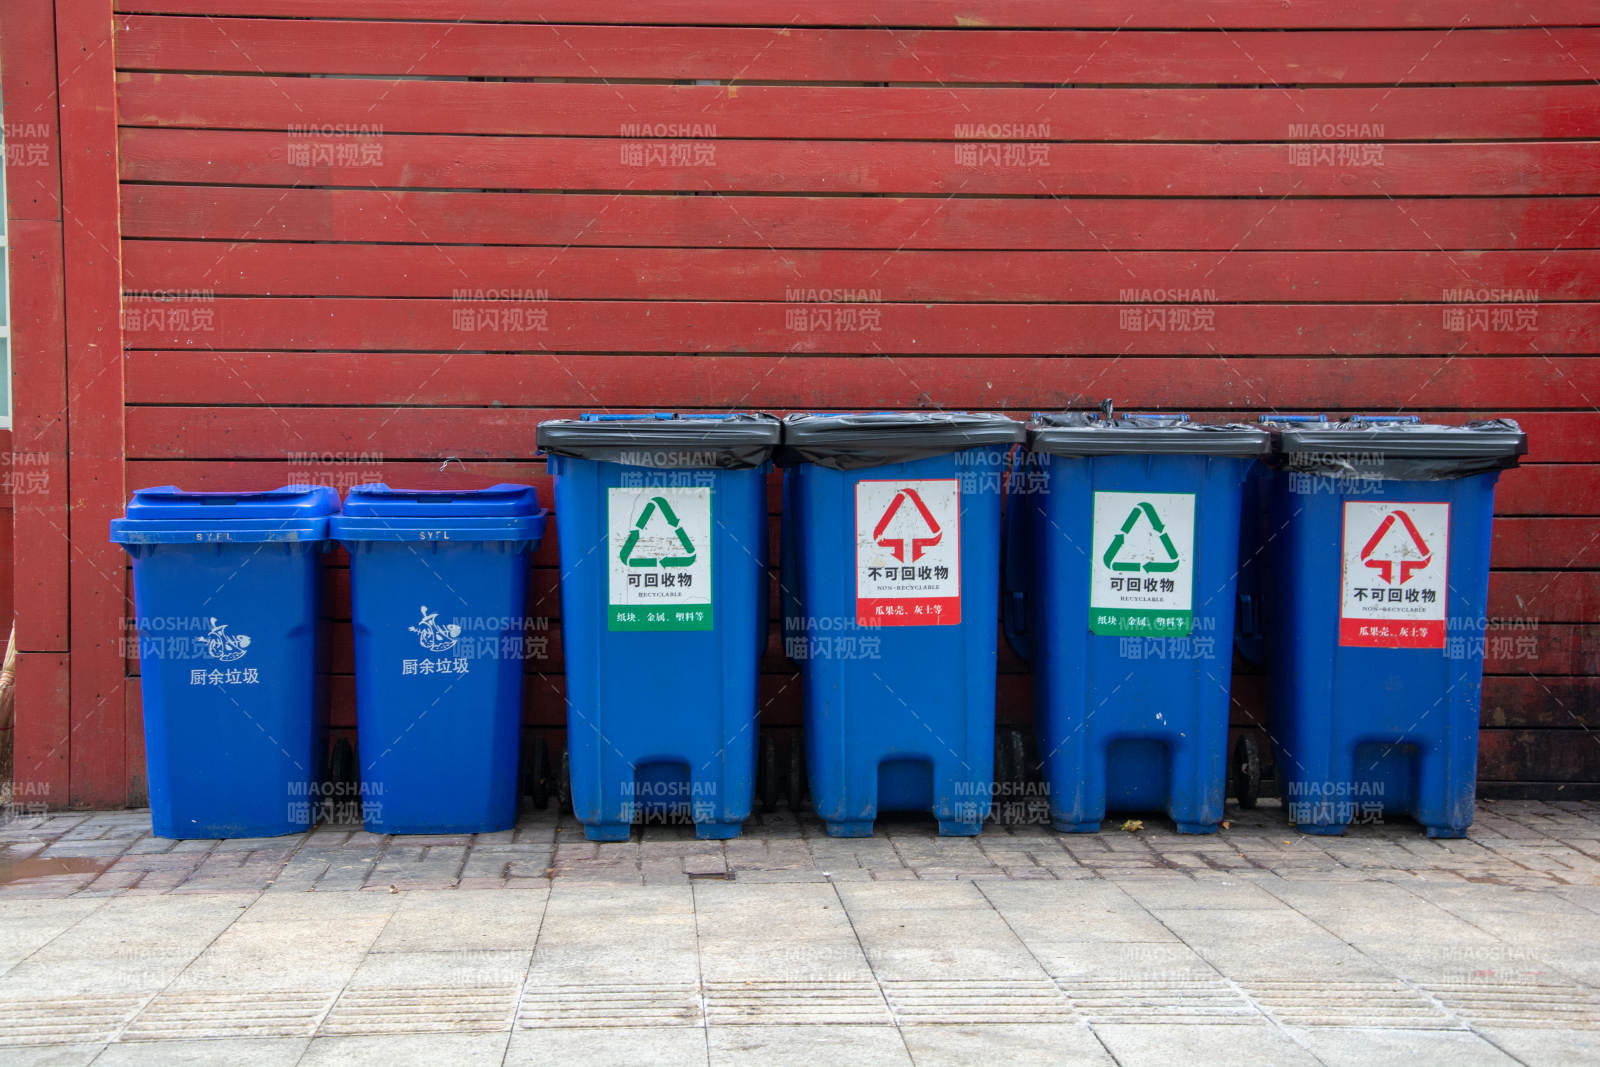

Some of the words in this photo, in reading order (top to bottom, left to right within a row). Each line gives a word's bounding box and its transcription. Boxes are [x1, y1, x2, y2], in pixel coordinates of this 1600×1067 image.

[628, 573, 693, 588] 可回收物
[868, 566, 949, 581] 不可回收物
[1110, 577, 1174, 592] 可回收物
[1354, 587, 1436, 603] 不可回收物
[402, 658, 469, 675] 厨余垃圾
[190, 668, 260, 685] 厨余垃圾
